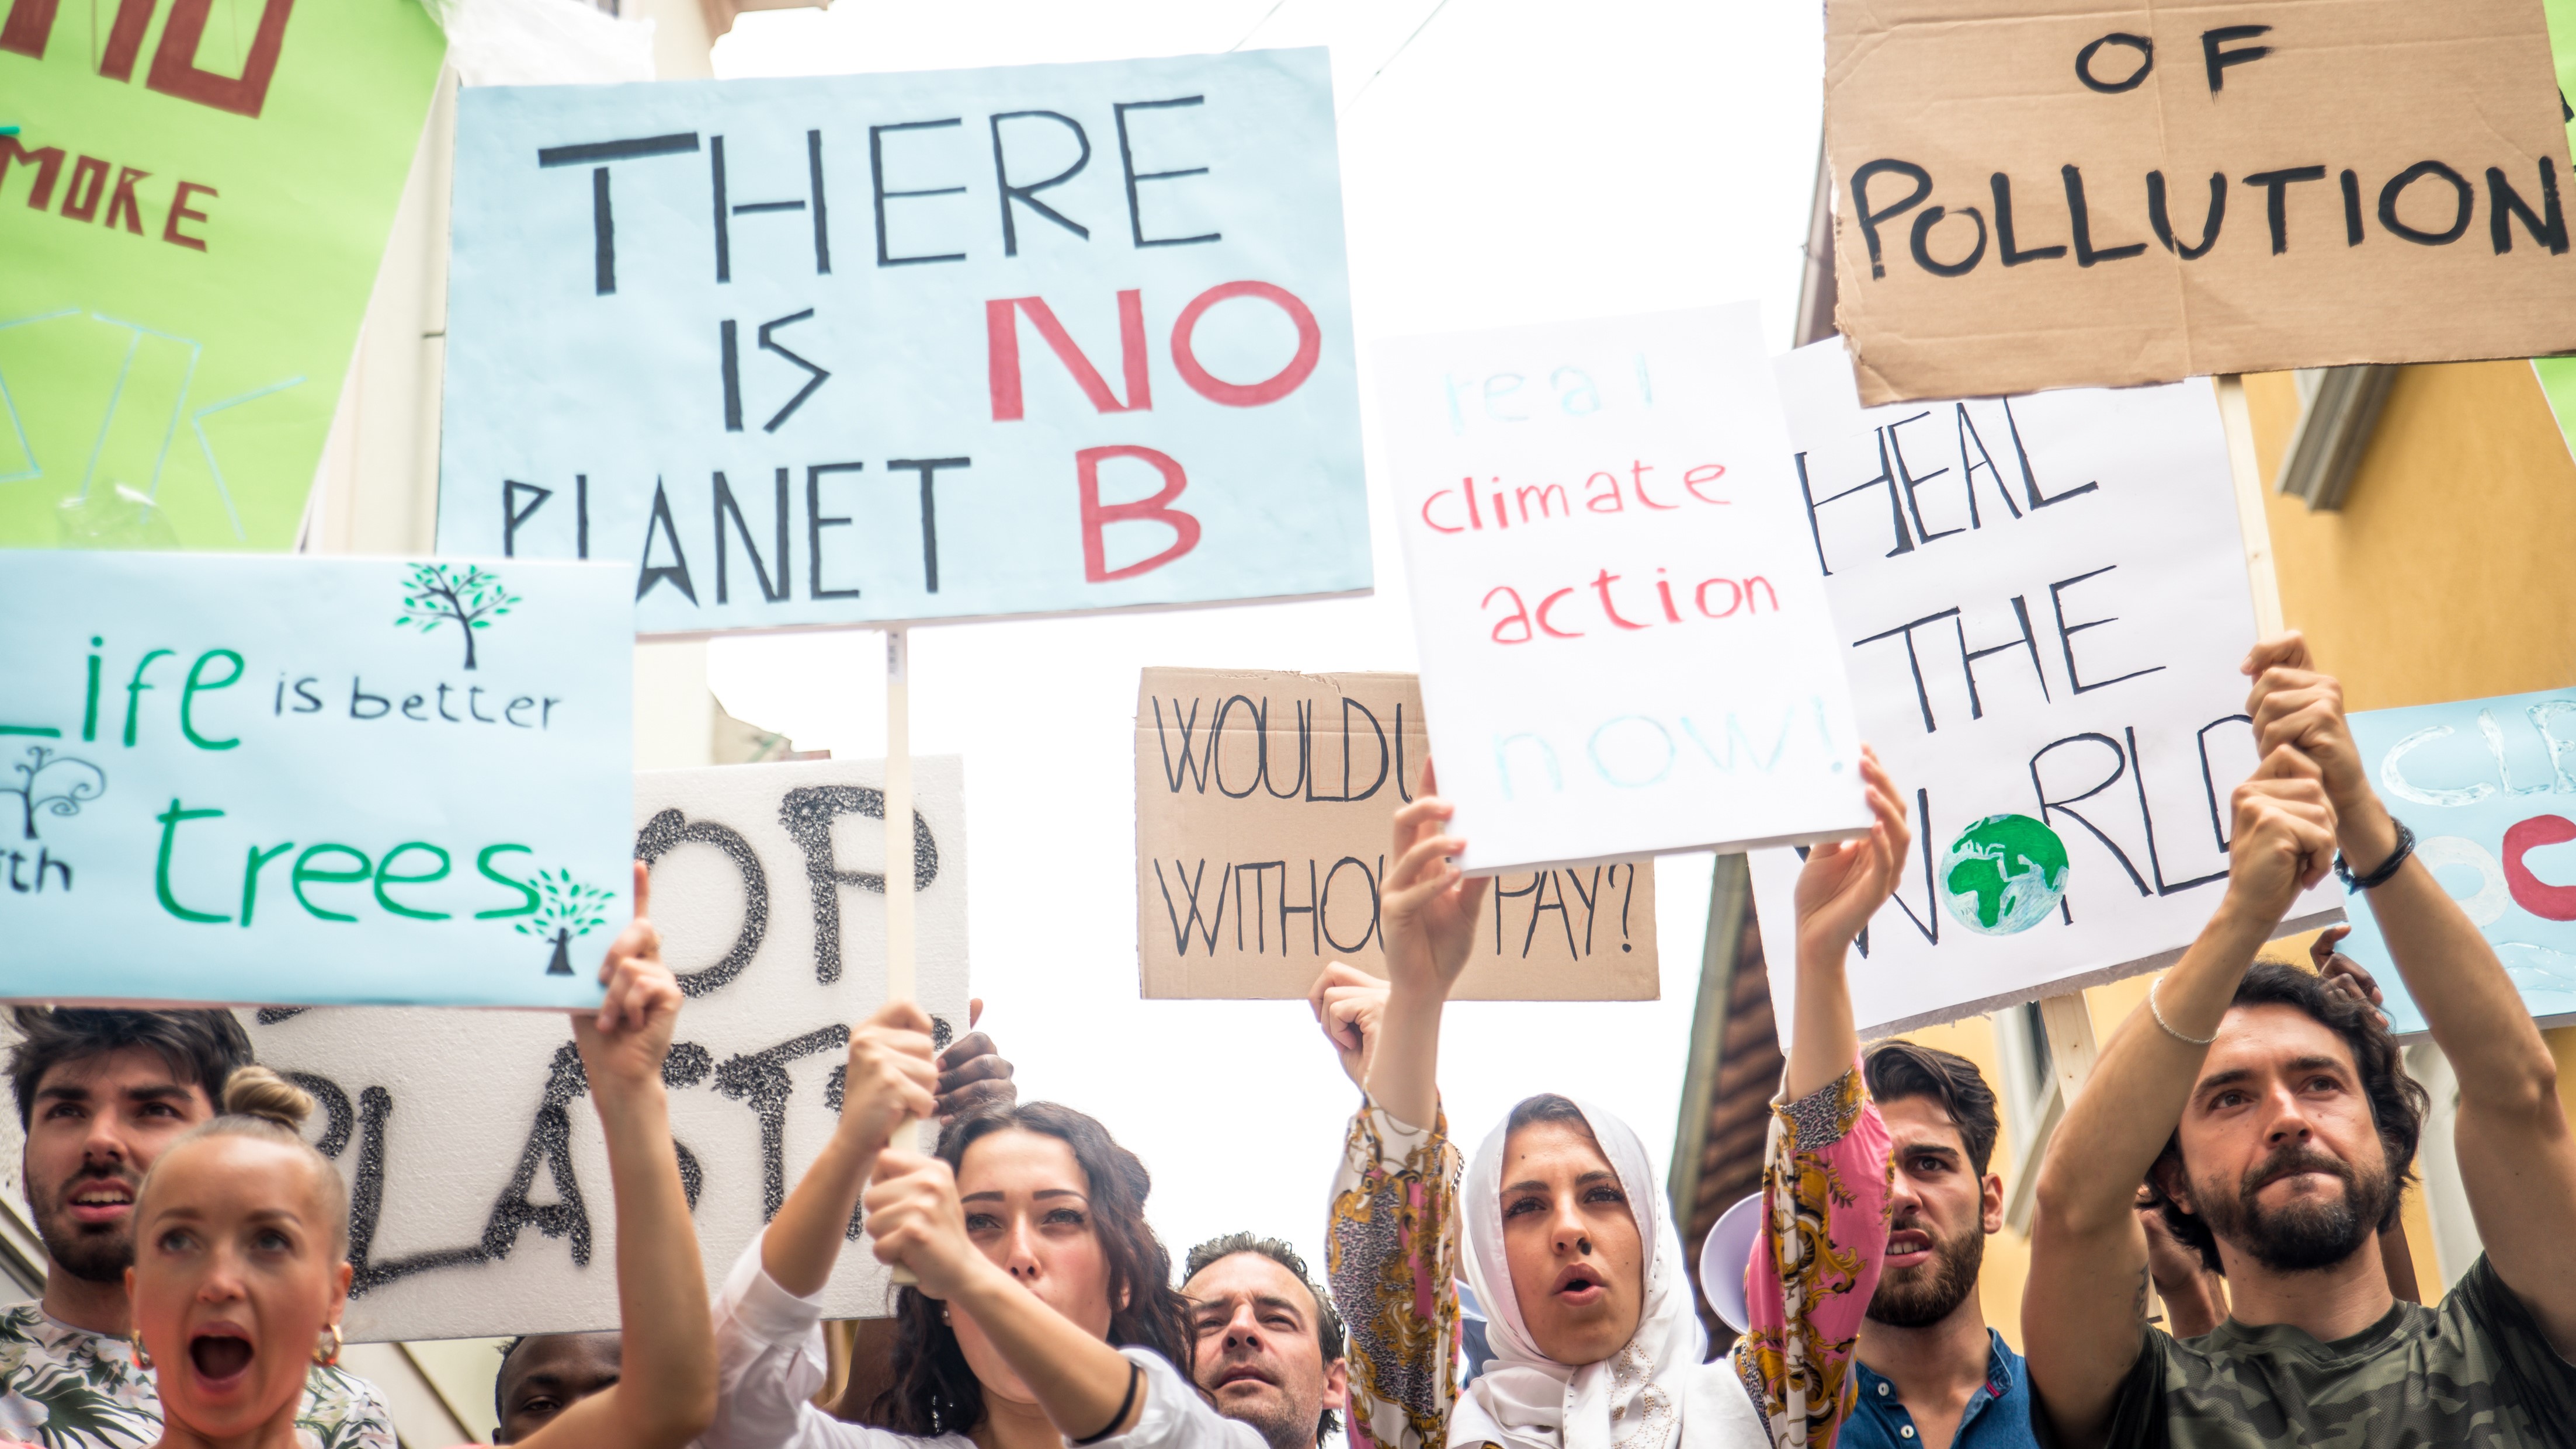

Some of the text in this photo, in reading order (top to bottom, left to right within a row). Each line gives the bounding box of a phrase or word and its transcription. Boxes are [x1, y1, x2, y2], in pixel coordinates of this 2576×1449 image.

[2075, 23, 2275, 102] OF
[0, 135, 220, 253] MORE
[537, 93, 1223, 296] THERE
[1850, 155, 2571, 280] POLLUTION
[721, 280, 1321, 432] IS NO
[1445, 352, 1654, 437] real
[1075, 444, 1202, 583] B
[1421, 460, 1733, 534] climate
[1794, 397, 2099, 576] HEAL
[1481, 568, 1780, 645] action
[1852, 565, 2167, 733] THE
[273, 672, 324, 717] is
[350, 675, 565, 730] better
[1152, 694, 1389, 803] WOULD
[1492, 694, 1845, 801] now!
[155, 797, 543, 928] trees
[1154, 855, 1634, 962] WITHO PAY?
